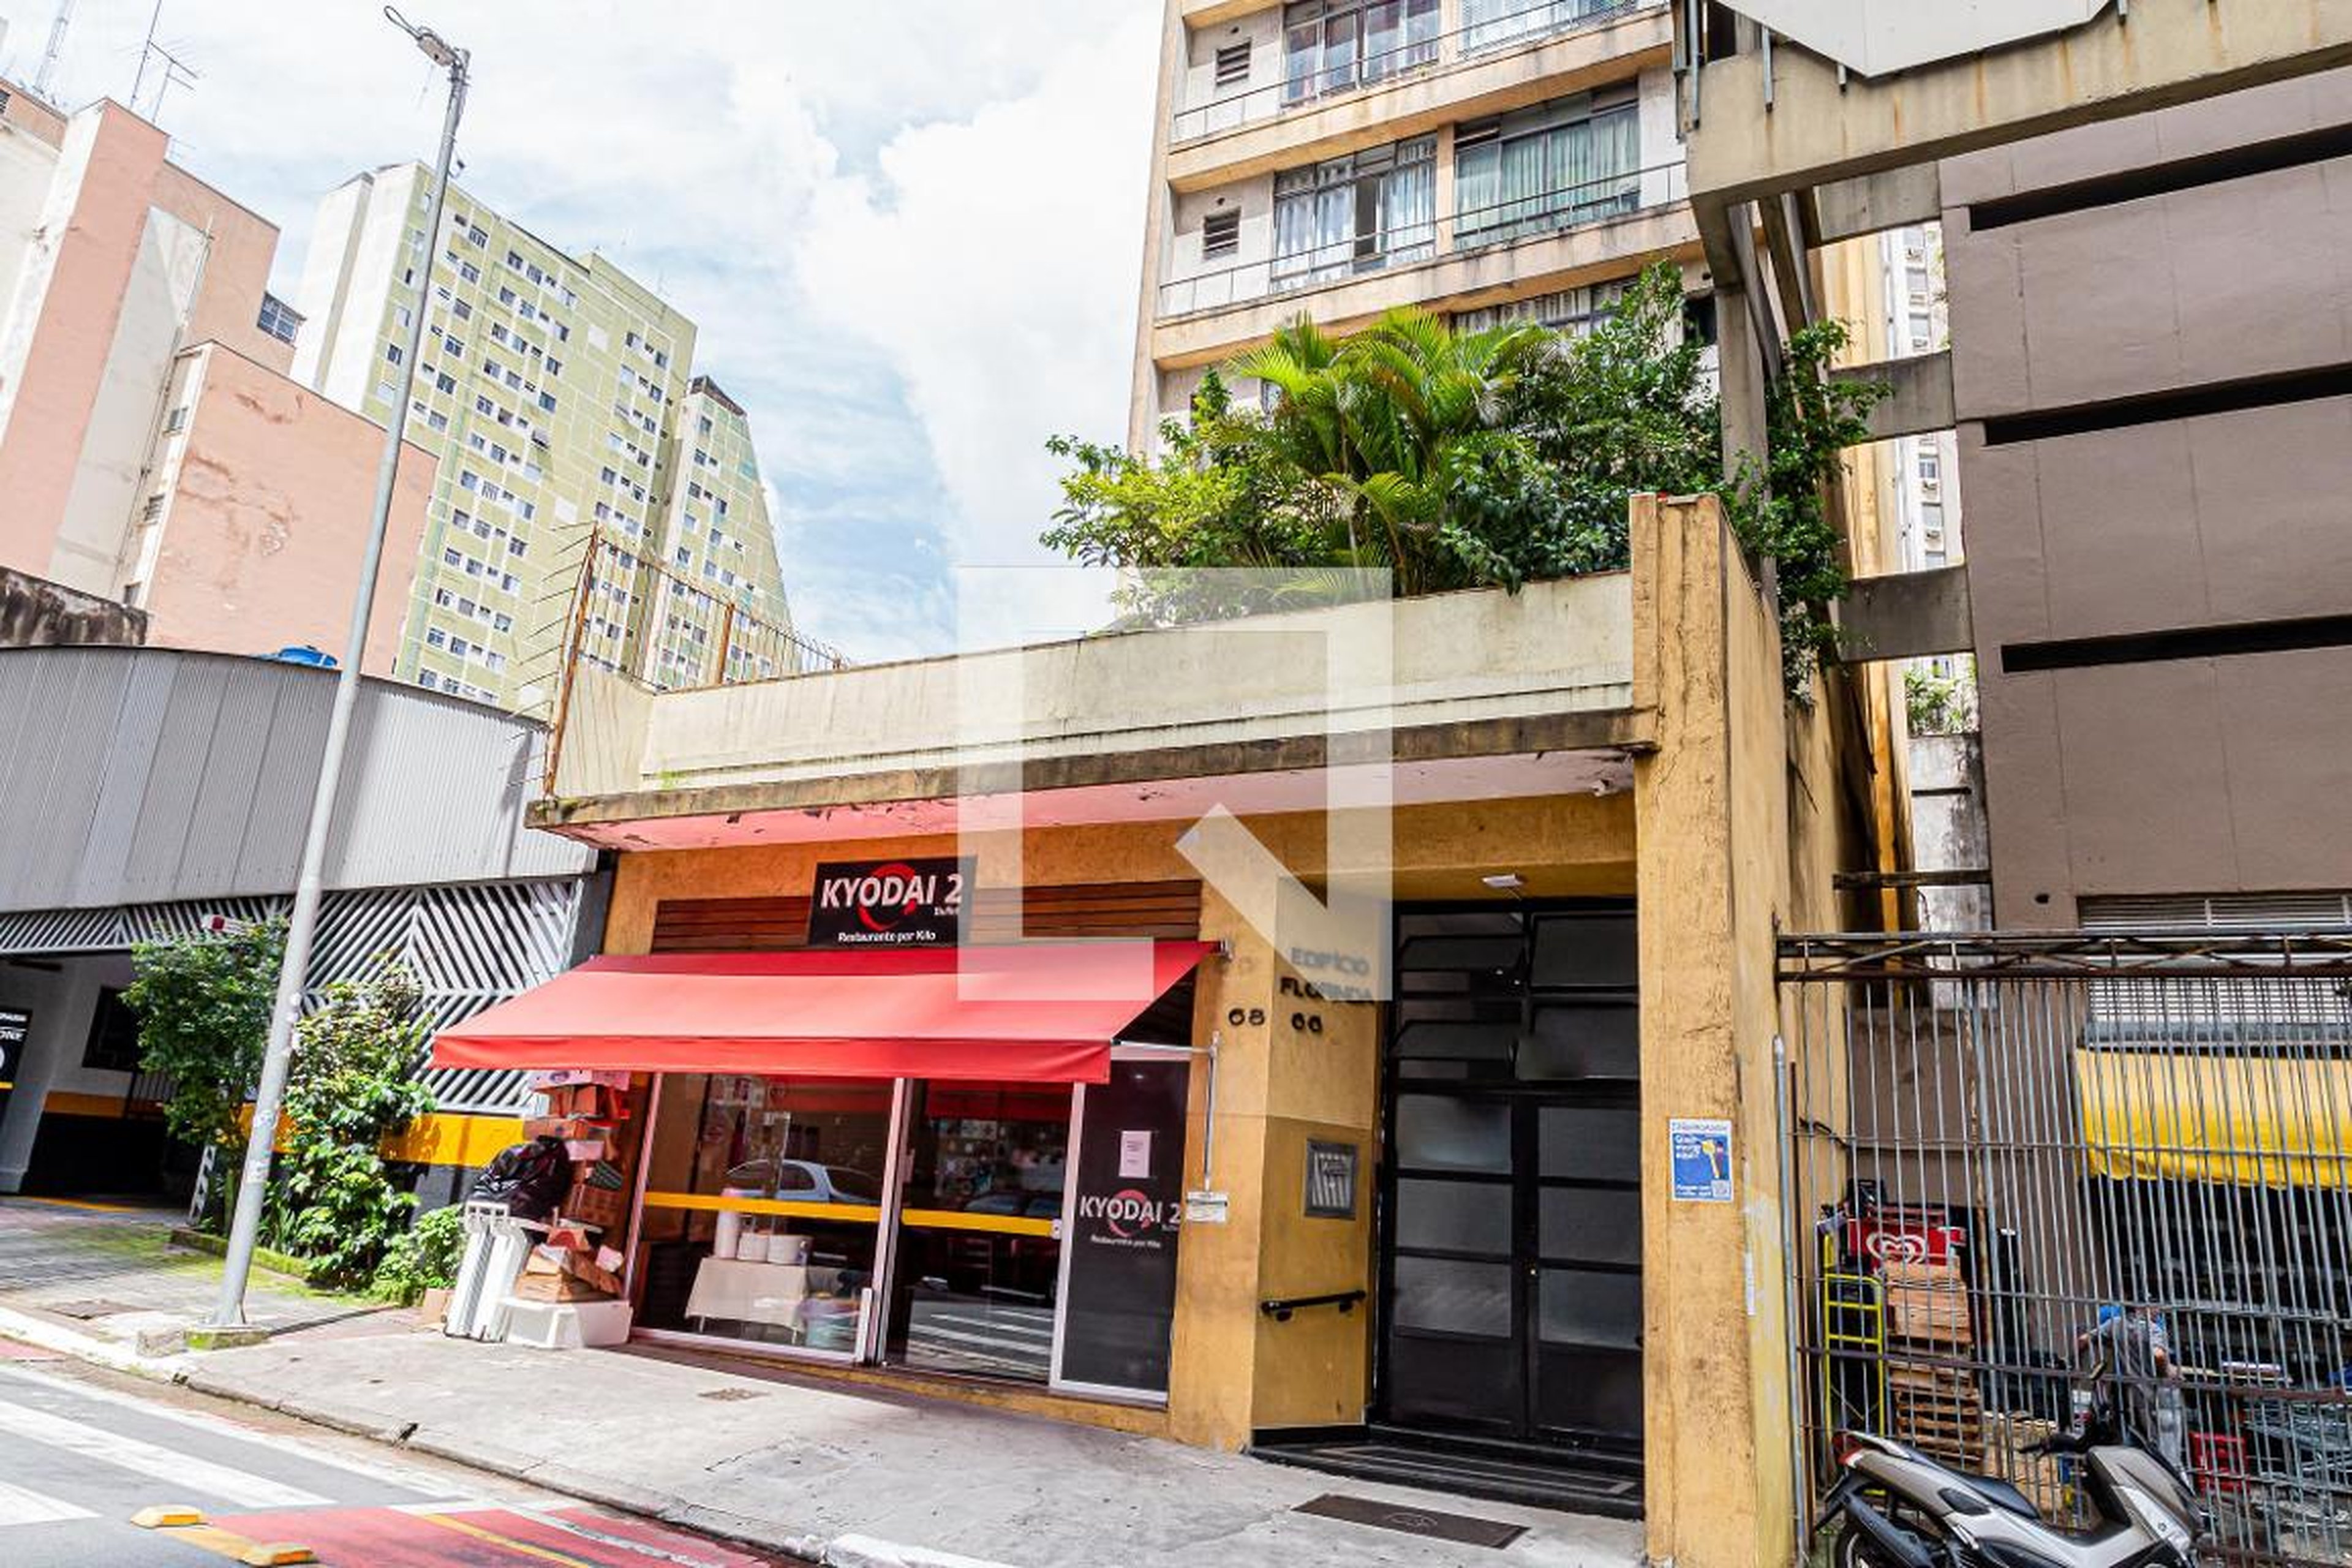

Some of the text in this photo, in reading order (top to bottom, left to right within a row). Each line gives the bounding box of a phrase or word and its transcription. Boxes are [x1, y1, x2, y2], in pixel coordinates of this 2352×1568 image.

[820, 873, 963, 908] KYODAI 2
[837, 930, 895, 942] Restaurante
[897, 931, 915, 943] por
[1228, 1008, 1265, 1027] 68
[1080, 1194, 1163, 1224] KYODAI
[1169, 1202, 1181, 1224] 2
